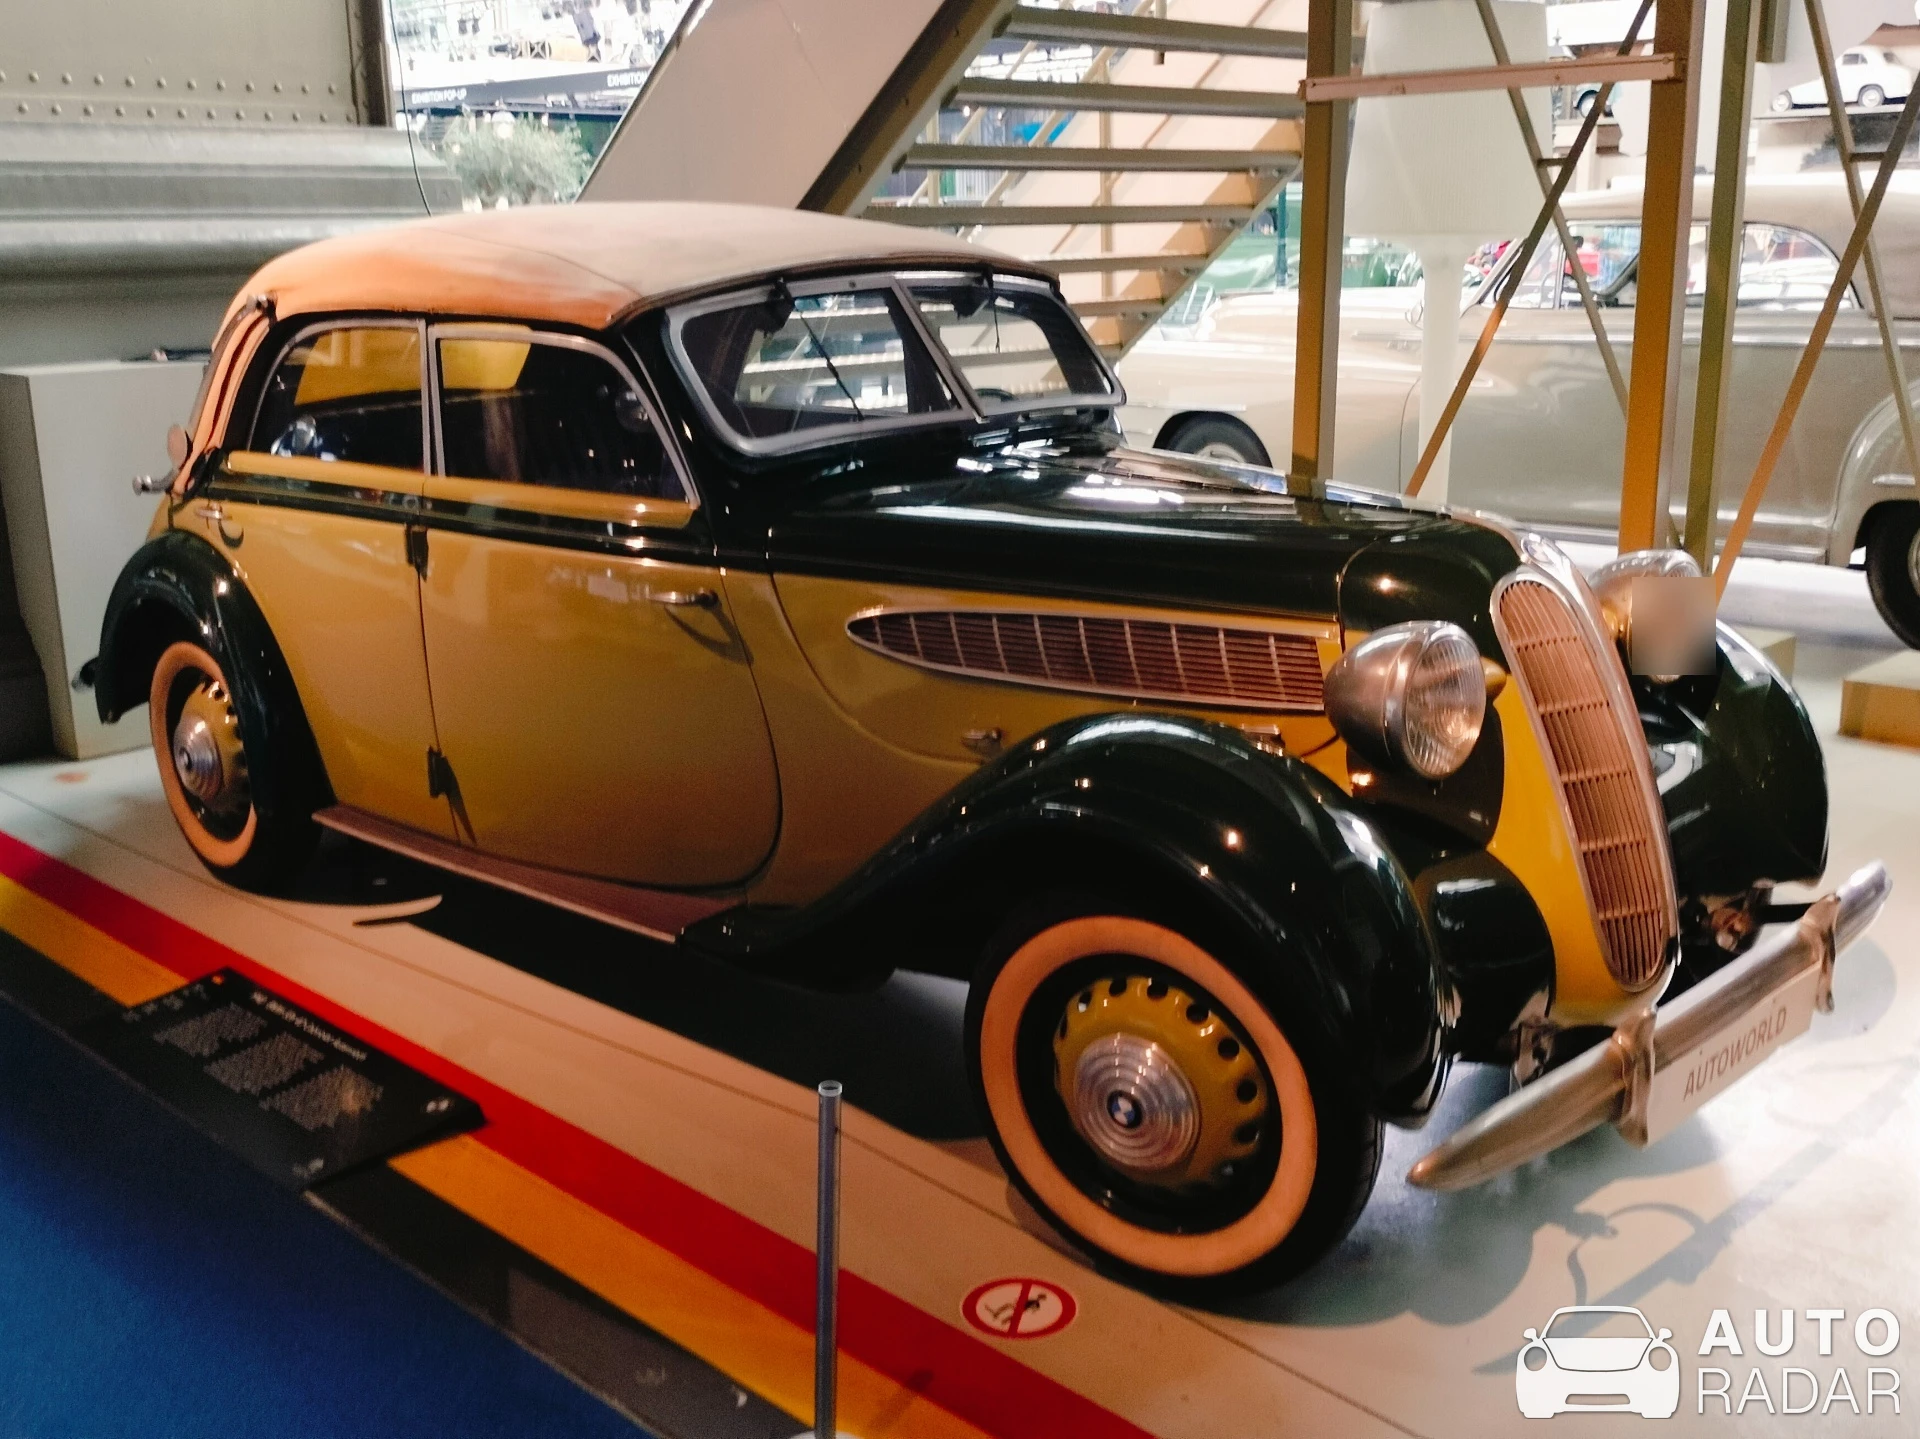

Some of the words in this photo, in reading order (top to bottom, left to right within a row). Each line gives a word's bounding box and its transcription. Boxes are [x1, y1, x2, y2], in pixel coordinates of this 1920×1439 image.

[411, 91, 443, 105] EXHIBITION
[444, 88, 467, 101] POP-UP
[1682, 1005, 1788, 1102] AUTOWORLD
